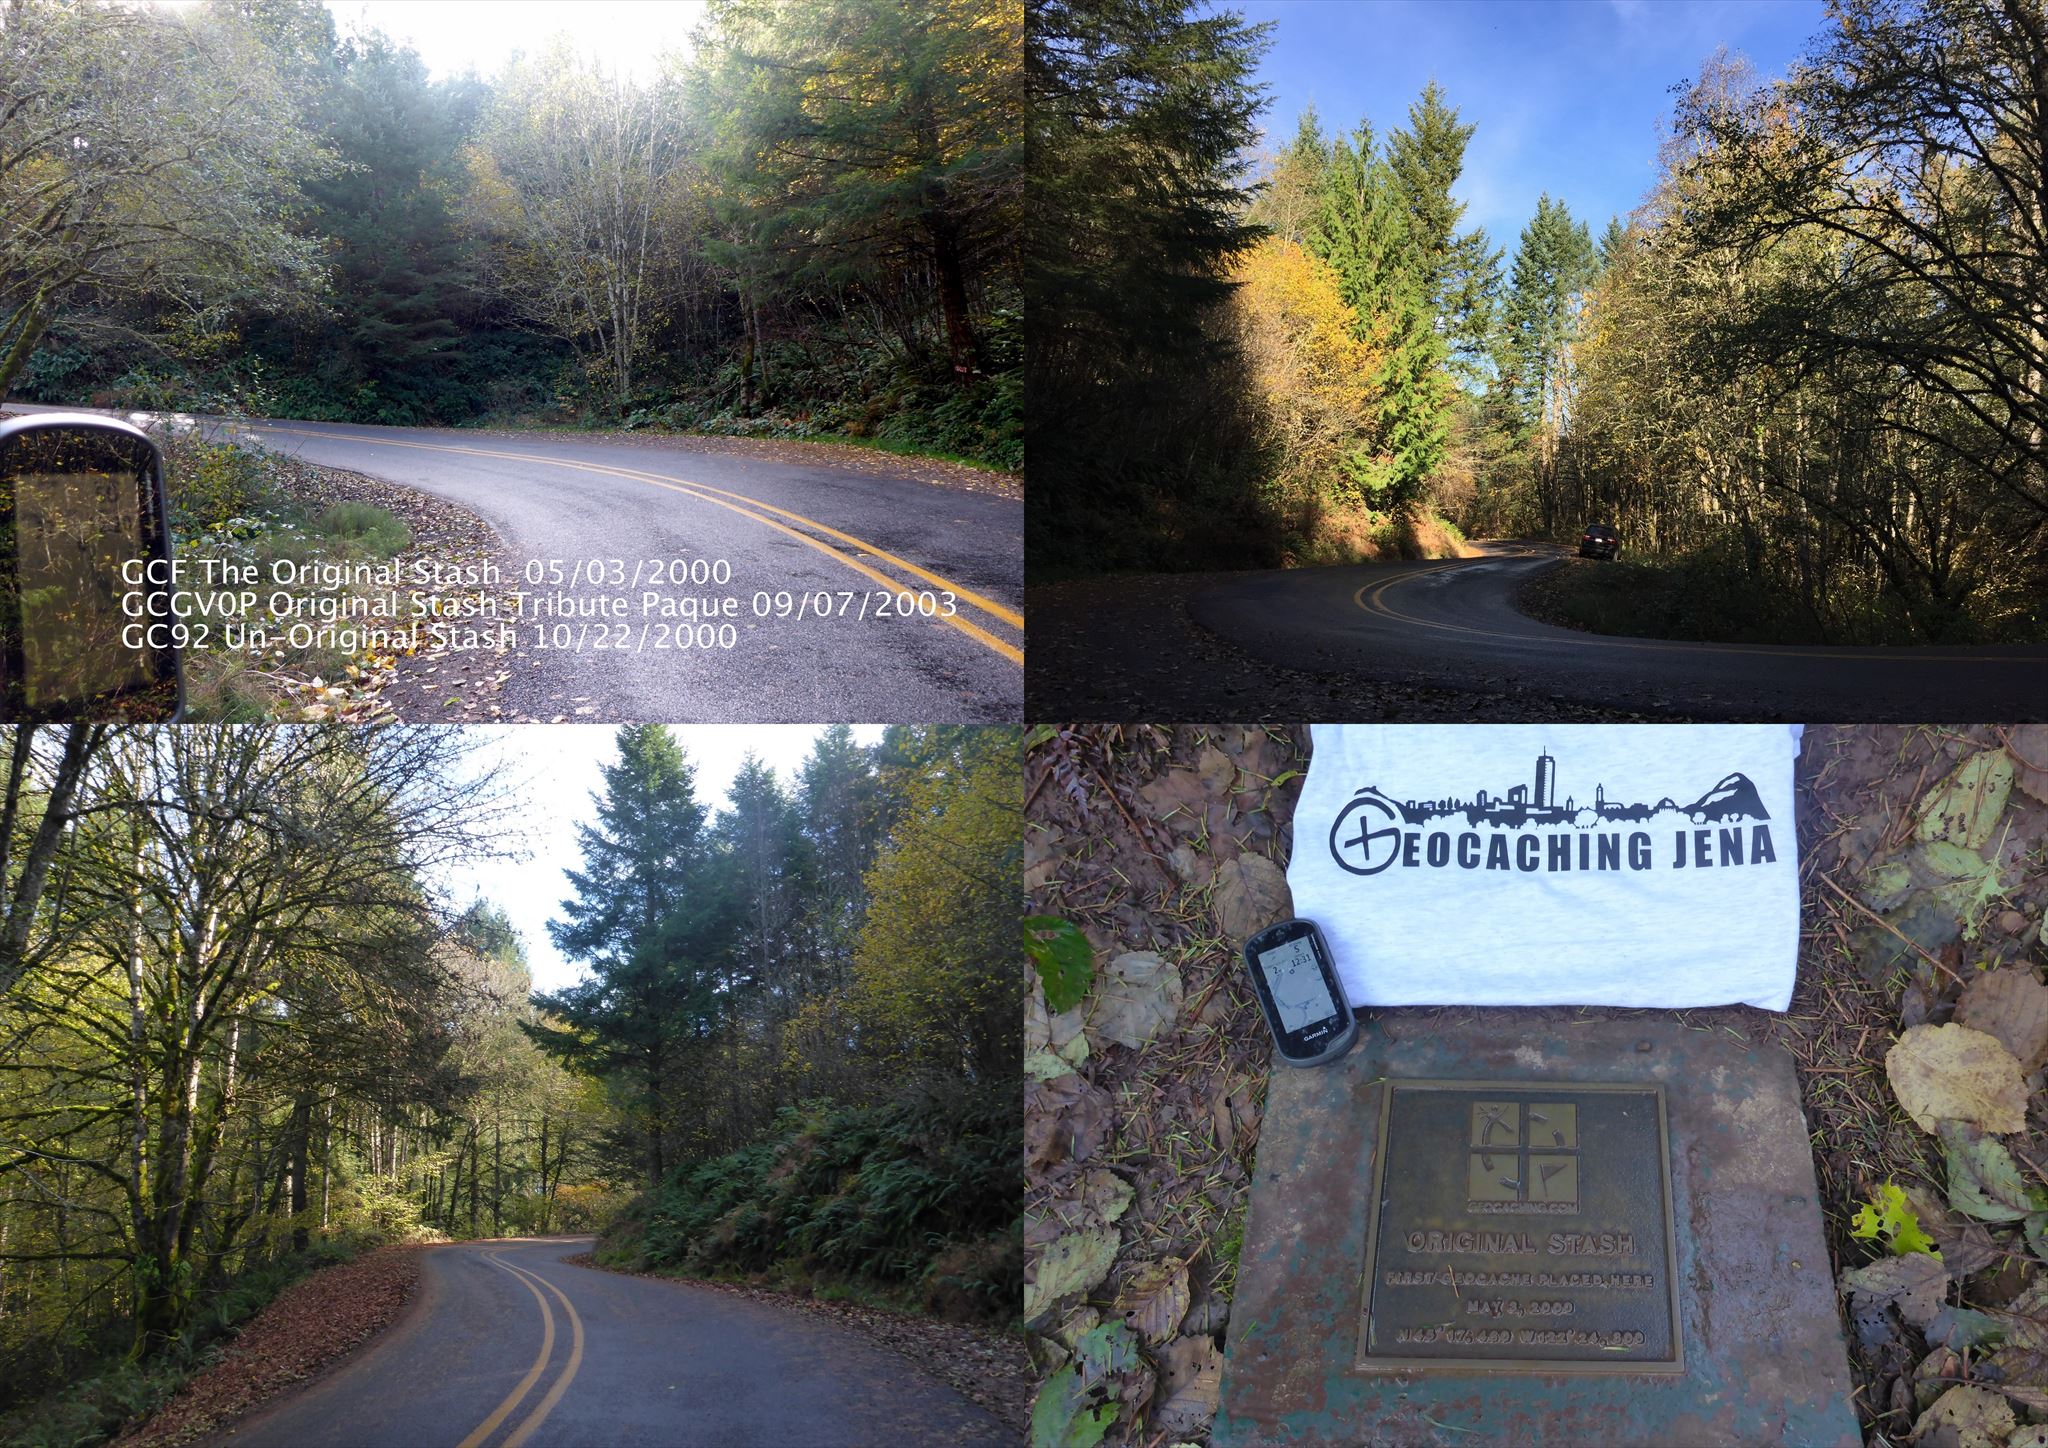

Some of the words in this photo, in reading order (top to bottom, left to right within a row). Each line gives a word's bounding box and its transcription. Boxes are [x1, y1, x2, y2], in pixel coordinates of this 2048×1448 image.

[1672, 824, 1777, 869] JENA
[1291, 954, 1311, 968] 12:31
[1304, 1027, 1328, 1042] GARMIN
[1406, 1231, 1538, 1254] ORIGINAL
[1547, 1233, 1635, 1255] STASH
[1386, 1271, 1435, 1286] FIRST
[1440, 1271, 1532, 1287] GEOCACHE
[1609, 1274, 1654, 1289] HERE
[1466, 1300, 1503, 1314] MAY
[1529, 1301, 1575, 1315] 2000
